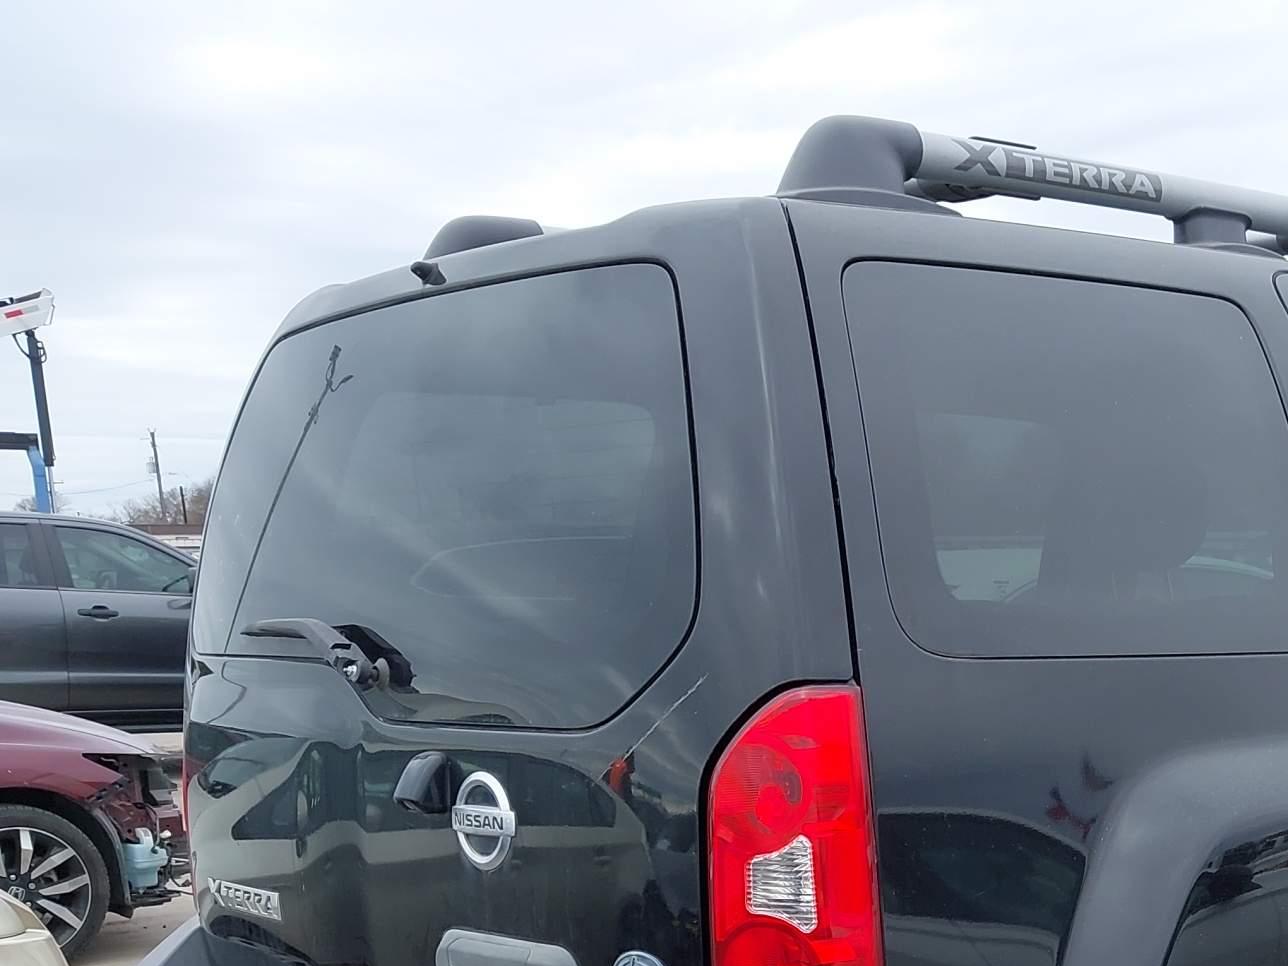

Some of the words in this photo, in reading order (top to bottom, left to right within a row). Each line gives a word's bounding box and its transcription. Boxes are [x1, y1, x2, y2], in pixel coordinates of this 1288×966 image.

[952, 138, 1161, 201] XTERRA
[454, 812, 504, 831] NISSAN
[207, 876, 281, 921] XTERRA
